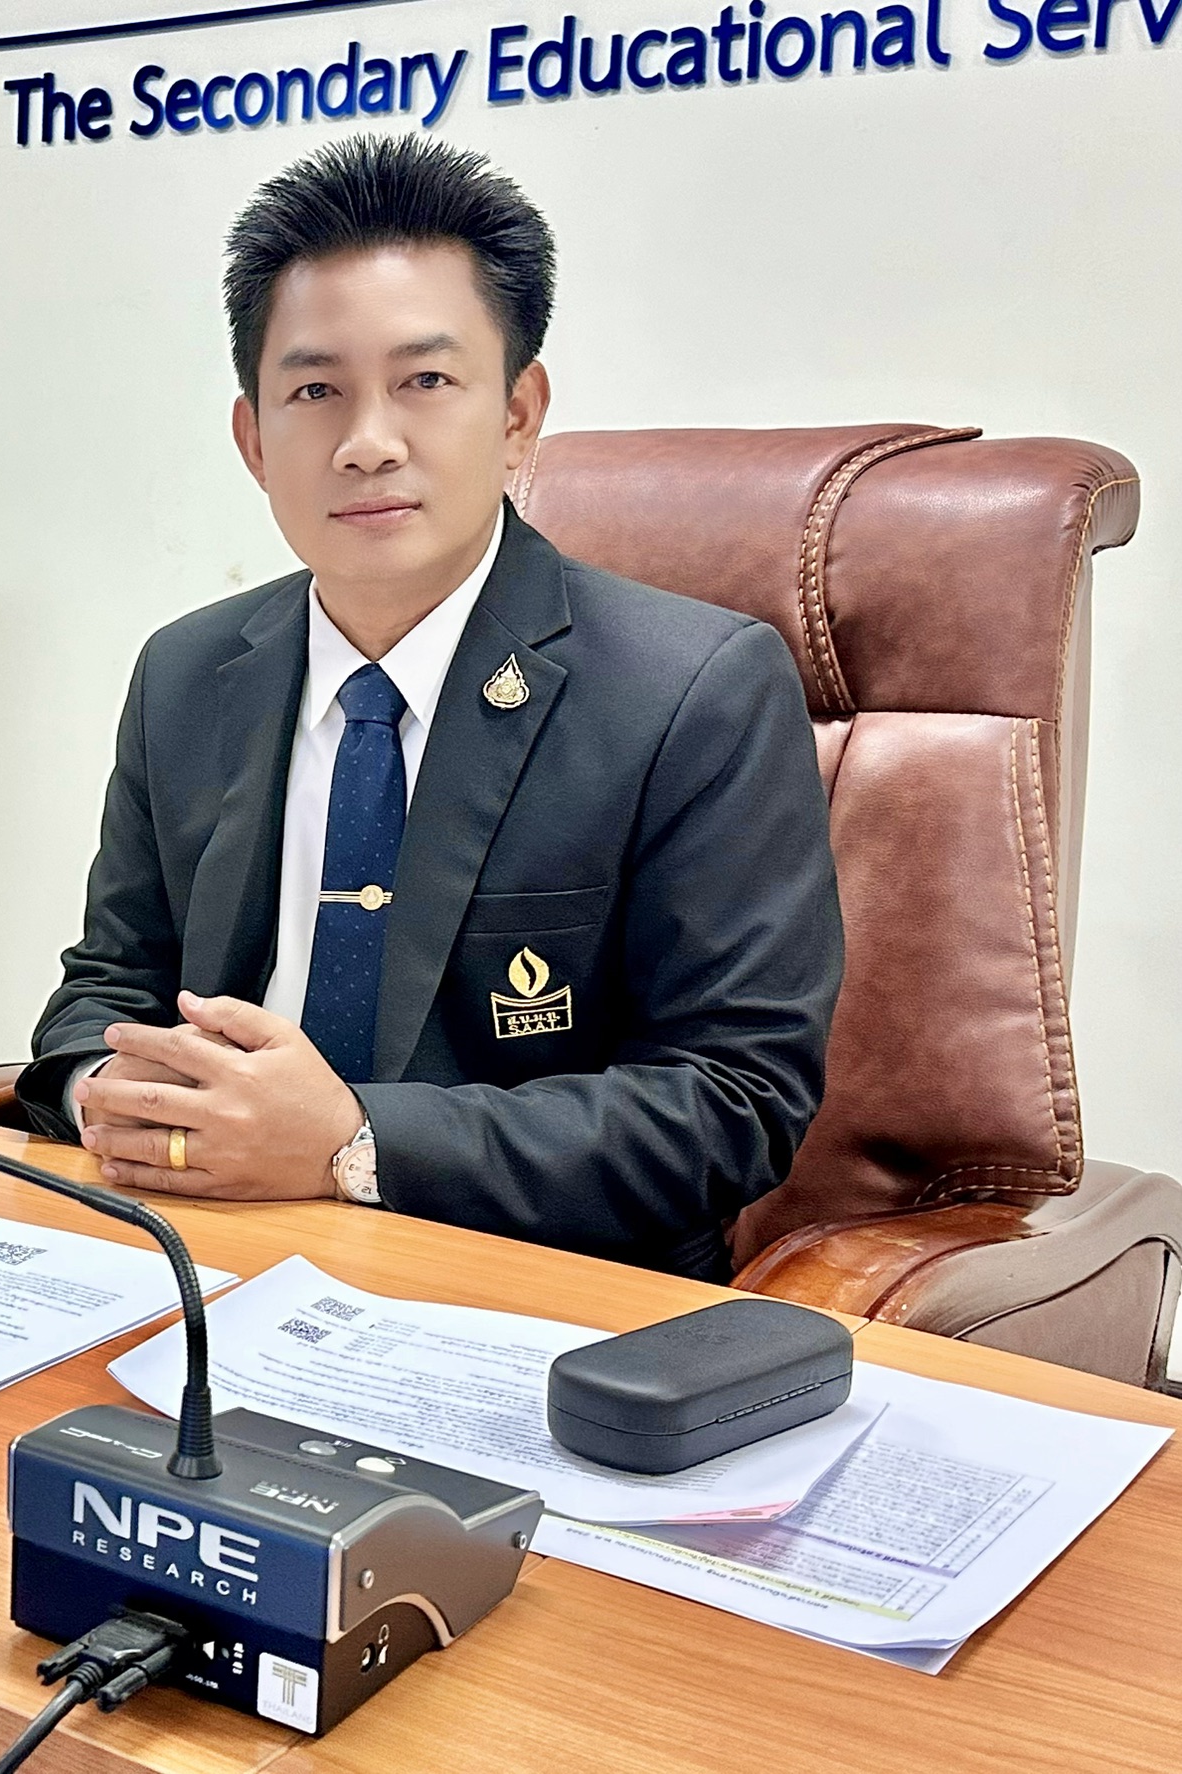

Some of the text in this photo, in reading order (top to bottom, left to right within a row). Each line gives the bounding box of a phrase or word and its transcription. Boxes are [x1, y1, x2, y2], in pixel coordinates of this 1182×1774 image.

[3, 72, 113, 146] The
[129, 41, 468, 129] Secondary
[487, 0, 952, 104] Educational
[73, 1480, 260, 1583] NPE
[248, 1483, 335, 1514] NPE
[72, 1530, 257, 1605] RESEARCH
